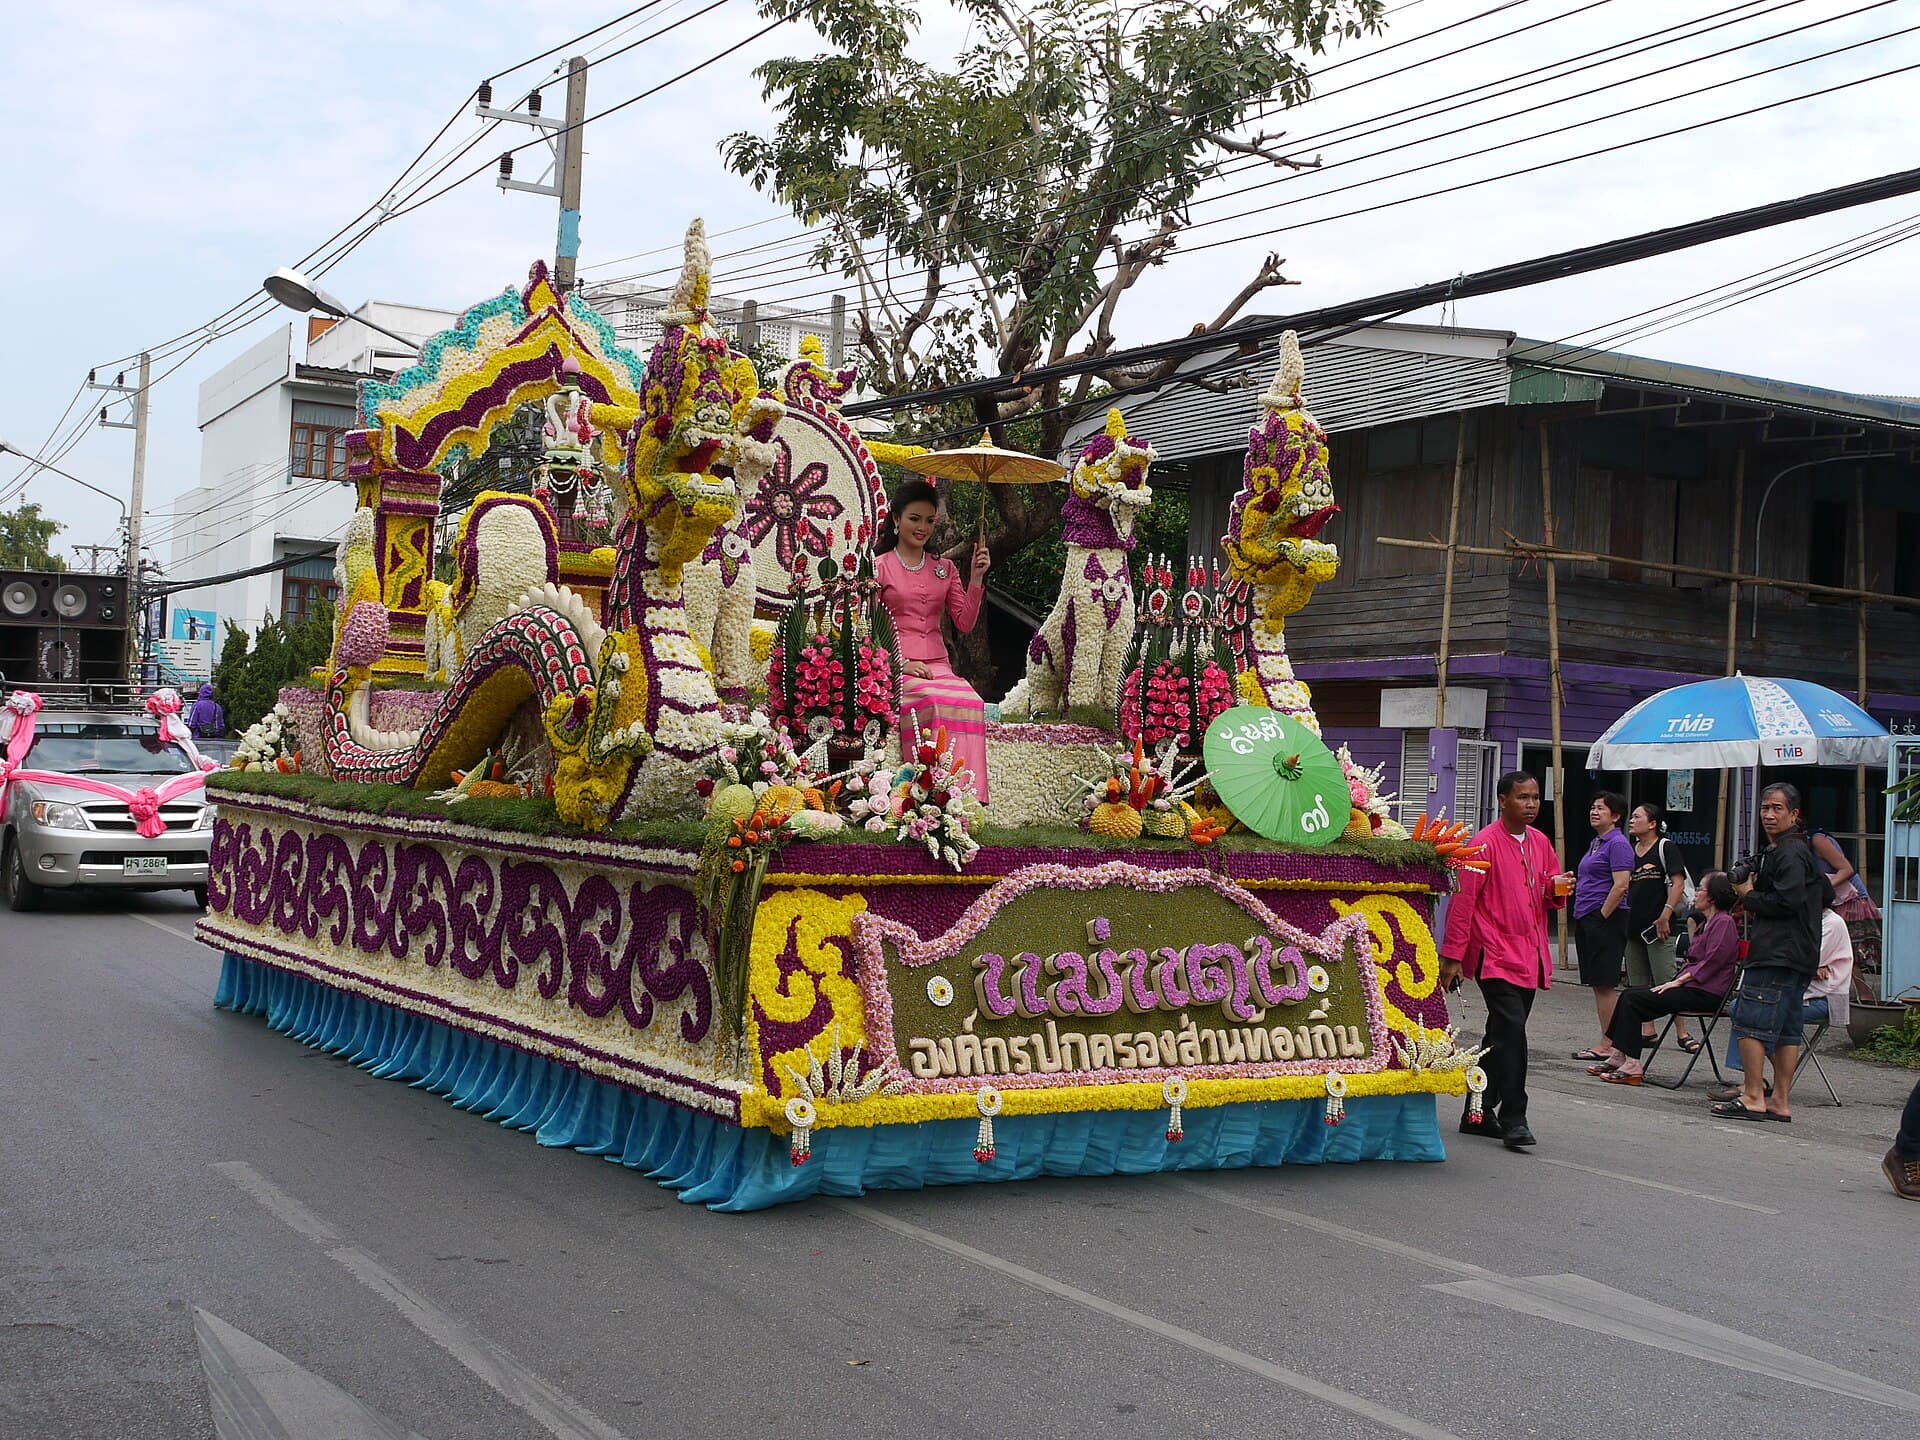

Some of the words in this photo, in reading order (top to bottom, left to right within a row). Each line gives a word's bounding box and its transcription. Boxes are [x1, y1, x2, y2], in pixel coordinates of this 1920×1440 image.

[1668, 713, 1715, 732] TMB
[1818, 709, 1851, 727] TMB
[1774, 743, 1803, 758] TMB
[143, 858, 165, 868] 2864
[971, 916, 1309, 1023] แม่แตง
